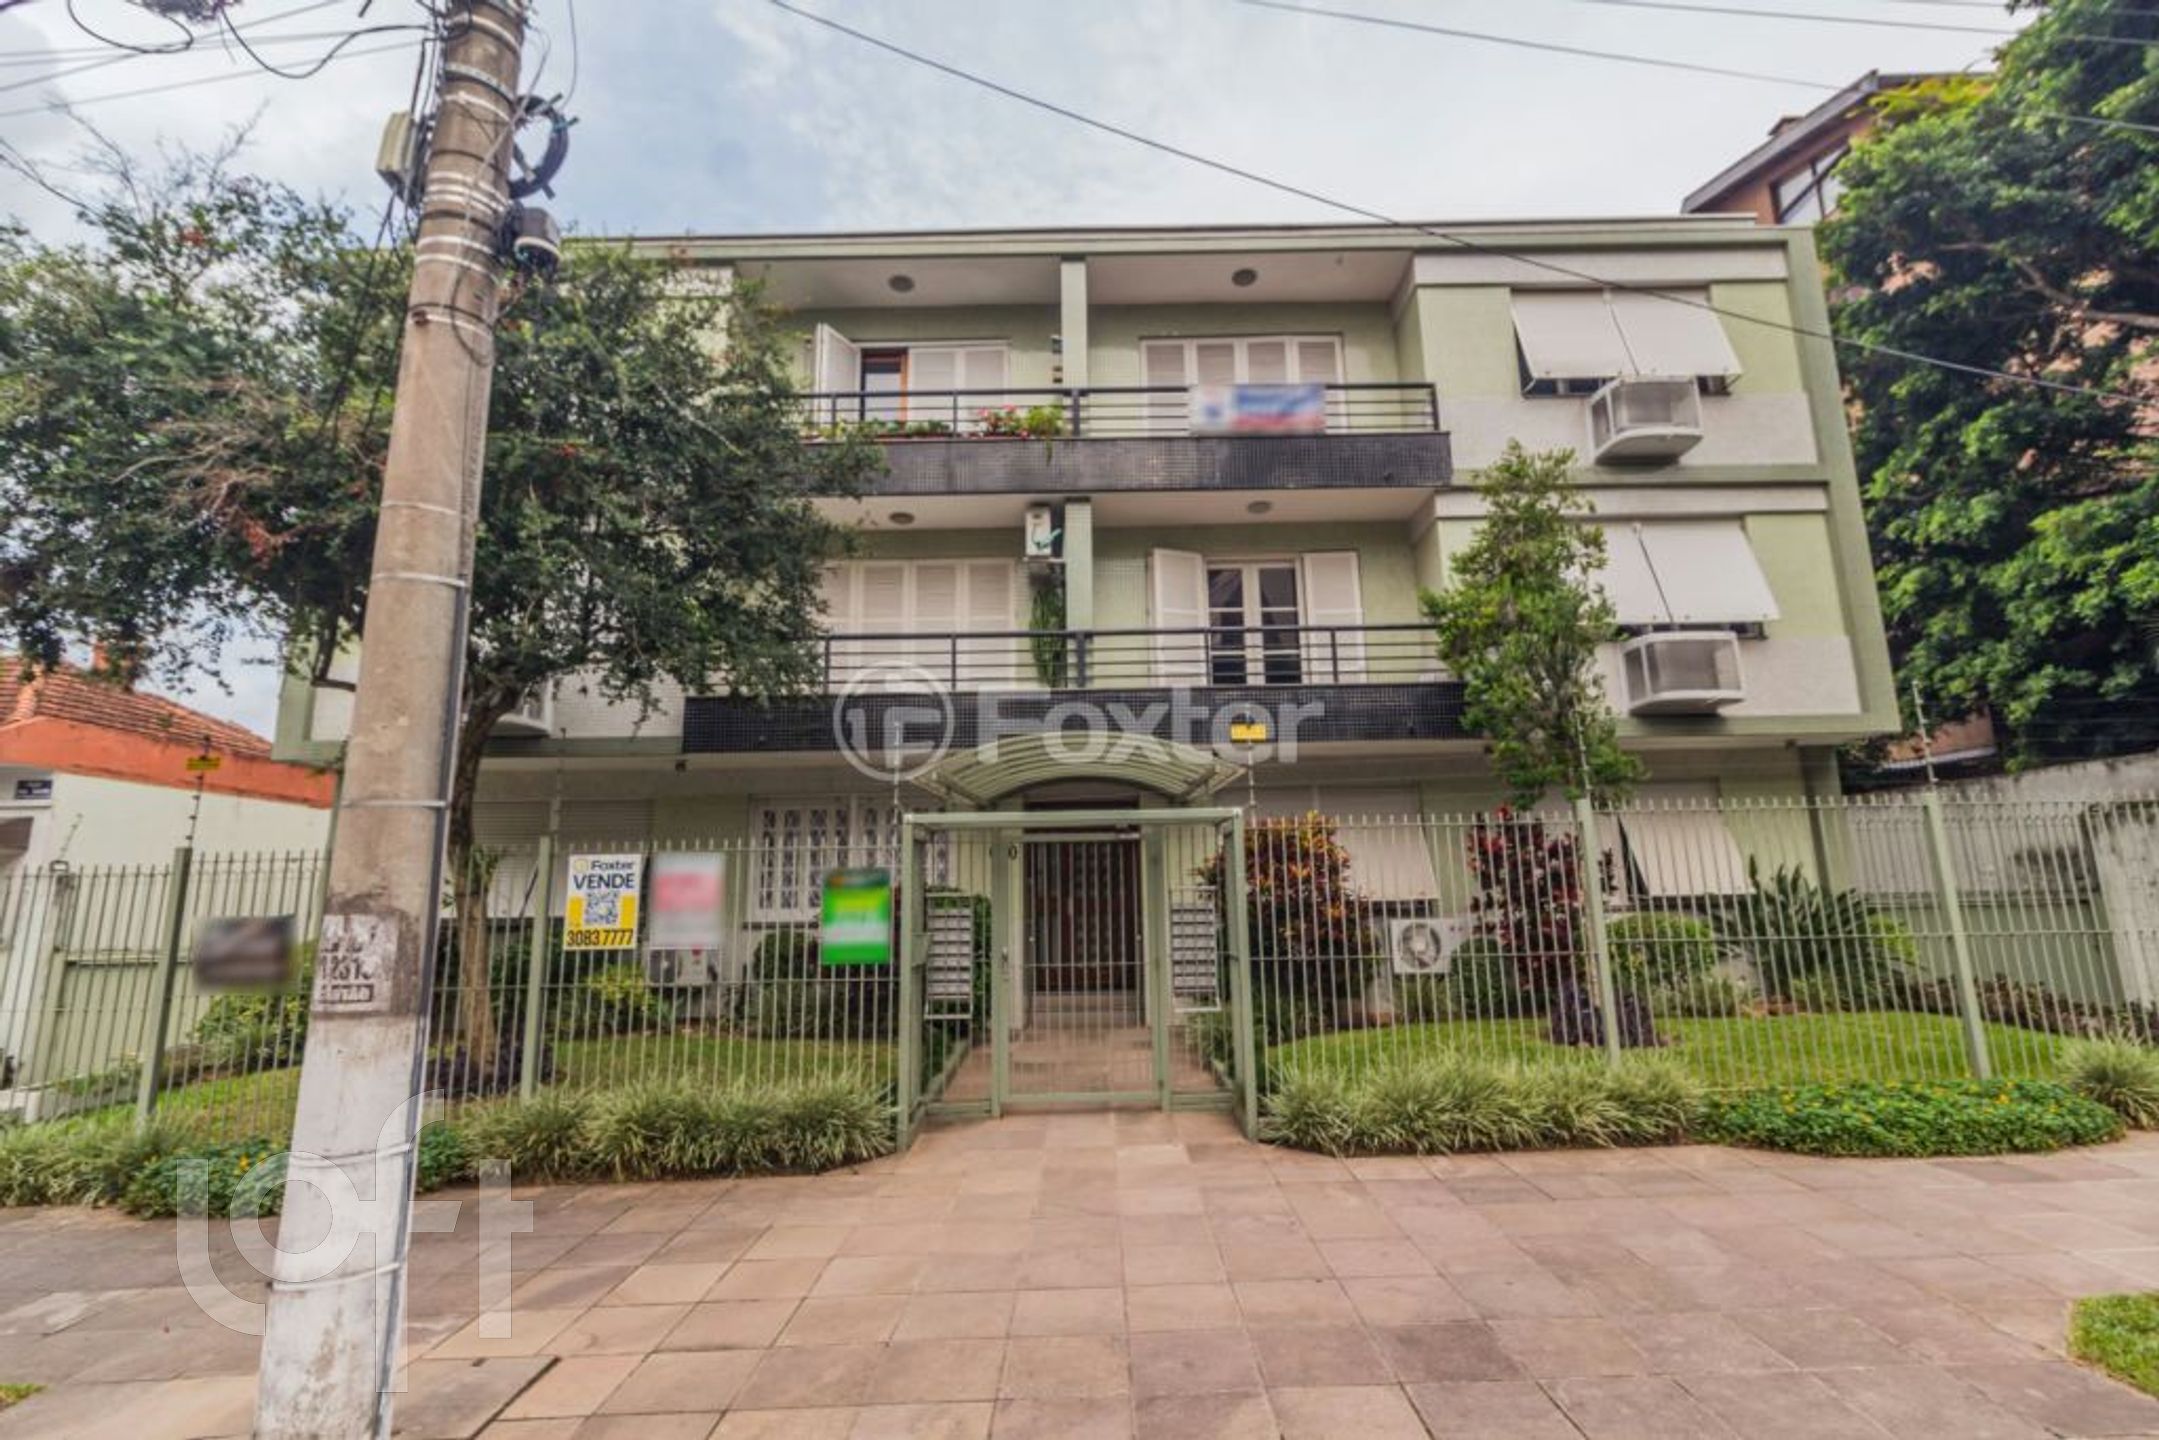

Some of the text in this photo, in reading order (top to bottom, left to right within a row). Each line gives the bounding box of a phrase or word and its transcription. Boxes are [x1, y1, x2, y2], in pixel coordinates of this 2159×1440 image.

[591, 860, 634, 871] Foxter
[573, 873, 635, 890] VENDE
[567, 928, 633, 946] 3083 7777
